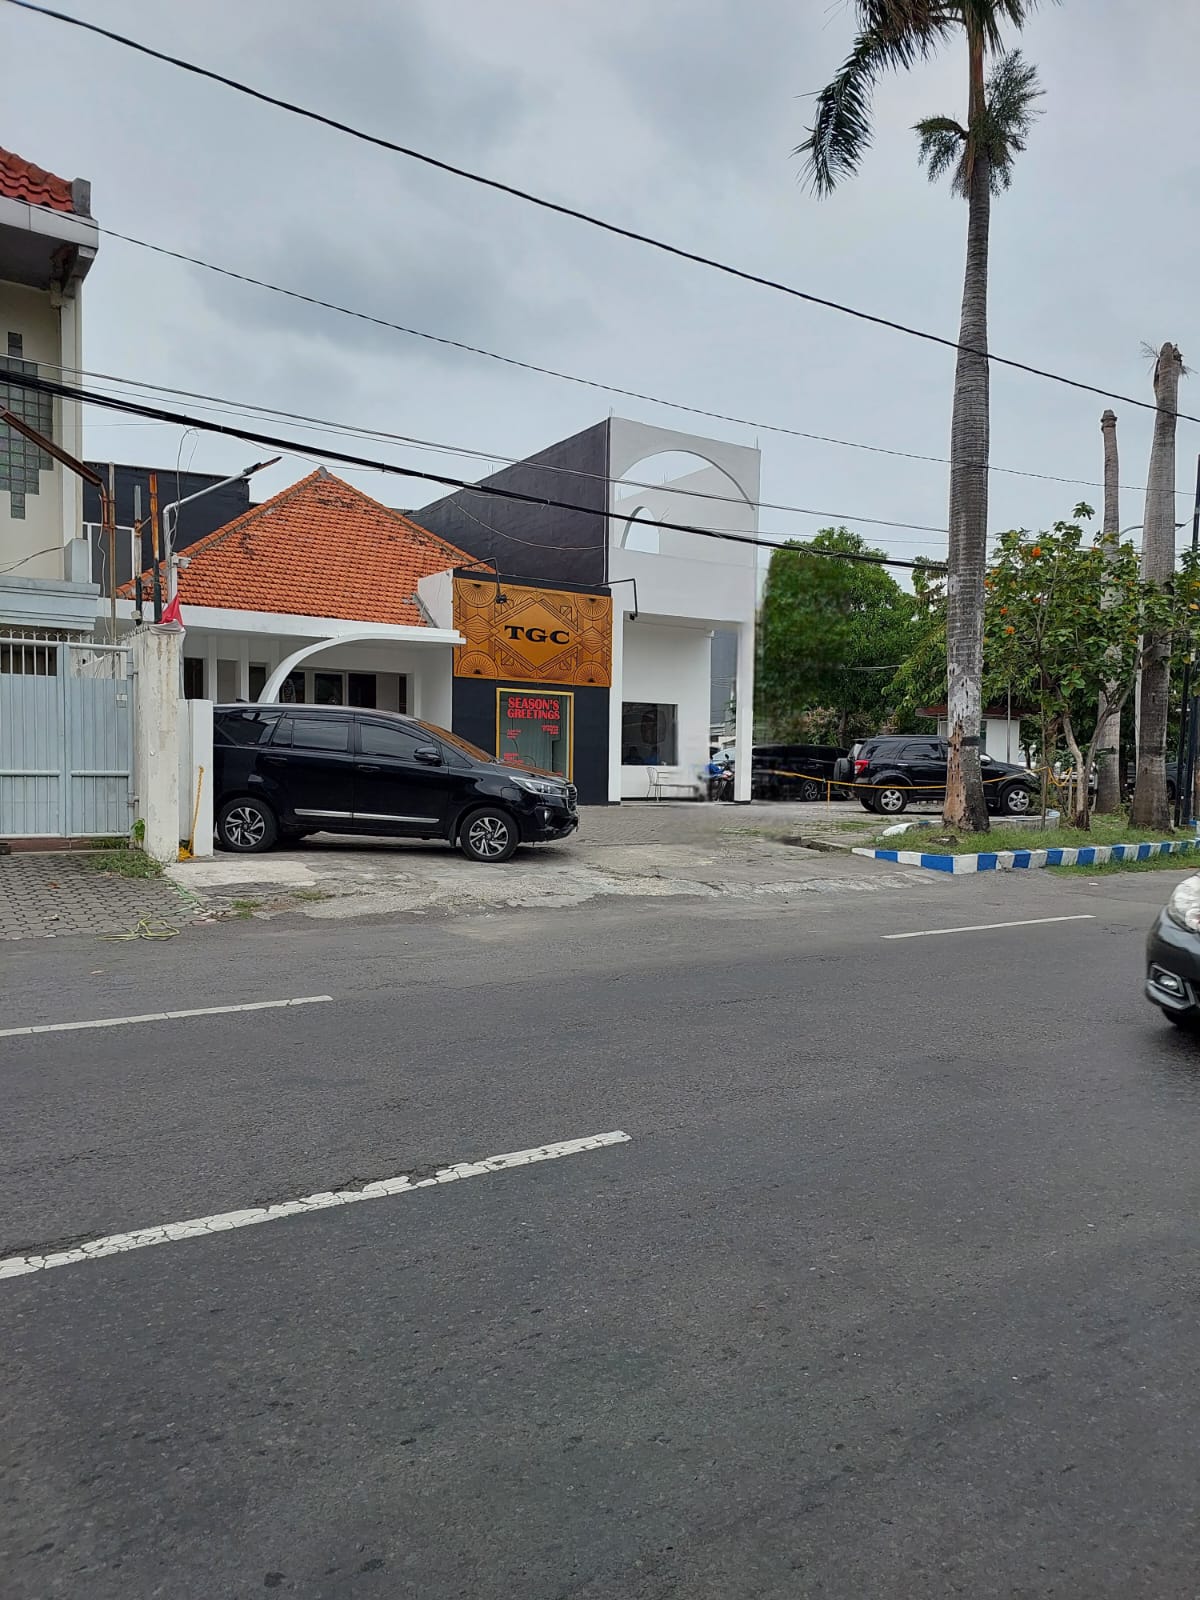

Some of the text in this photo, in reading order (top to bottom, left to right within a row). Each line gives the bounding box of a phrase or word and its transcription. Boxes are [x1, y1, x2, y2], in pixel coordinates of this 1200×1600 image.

[504, 625, 570, 645] TGC
[508, 697, 560, 710] SEASON'S
[507, 708, 560, 720] GREETINGS
